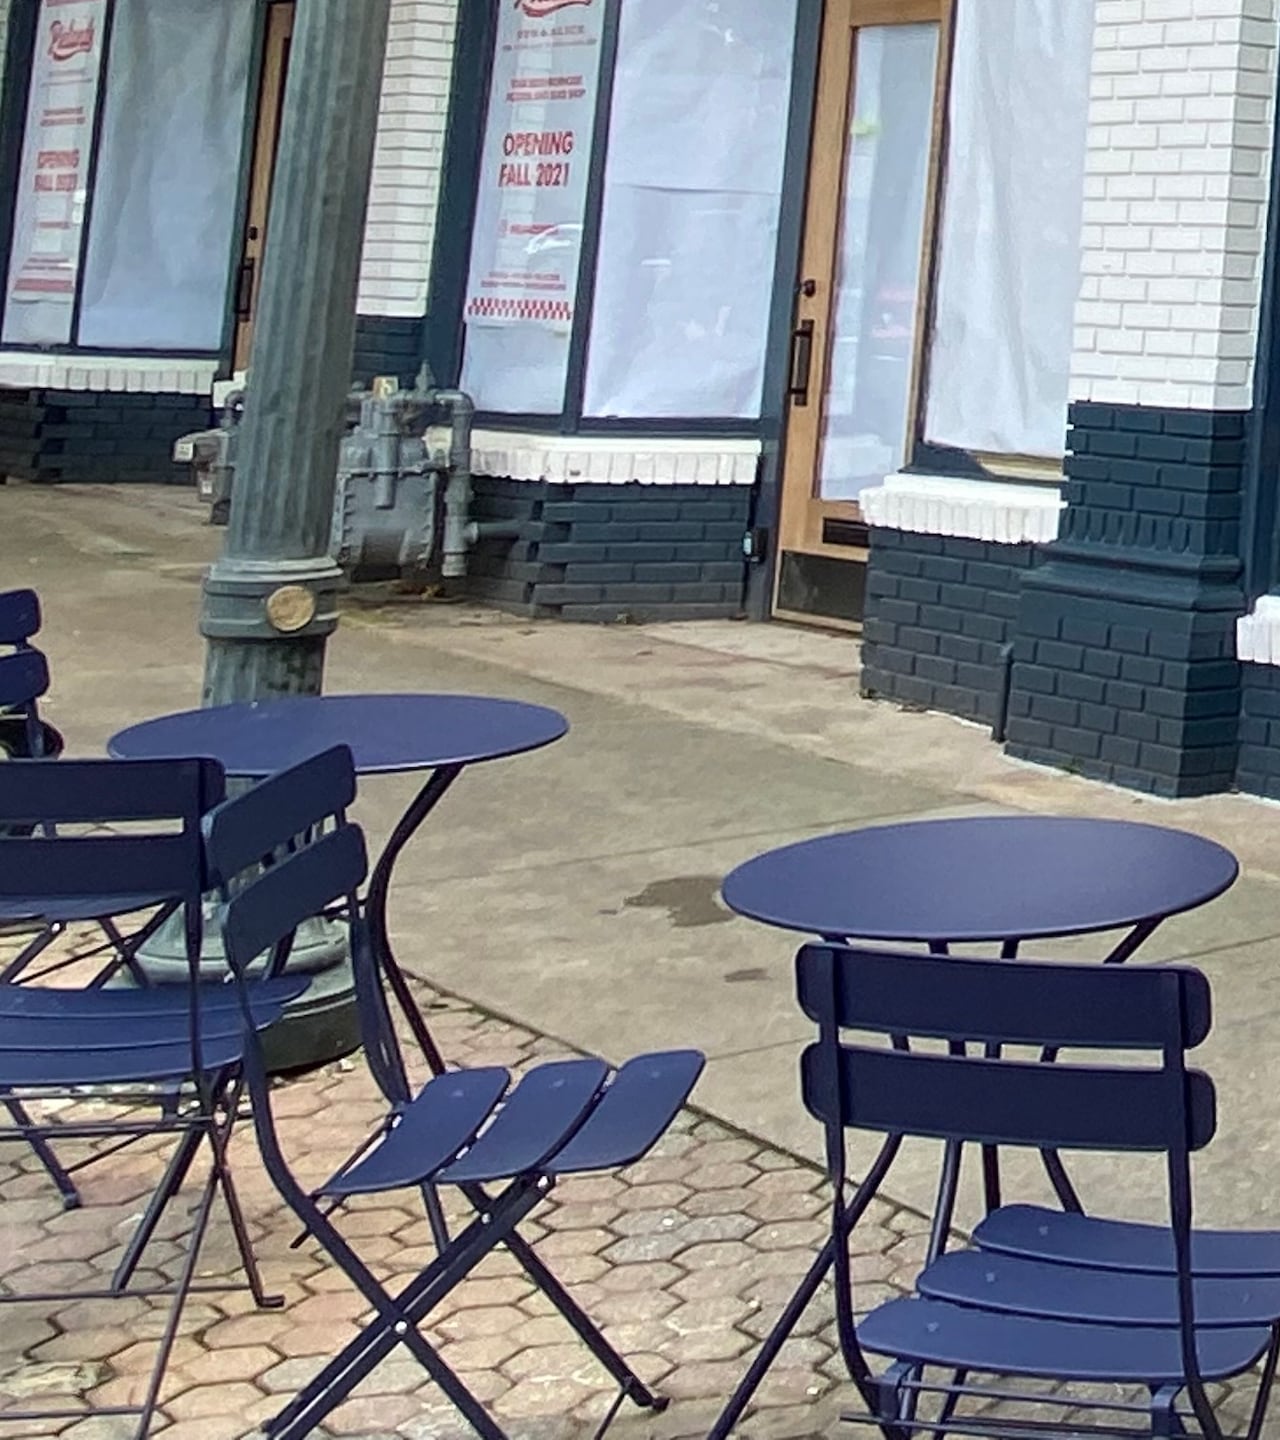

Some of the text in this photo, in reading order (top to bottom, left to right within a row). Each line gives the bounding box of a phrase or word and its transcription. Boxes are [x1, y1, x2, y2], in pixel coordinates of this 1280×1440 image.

[503, 131, 573, 157] OPENING
[498, 162, 570, 188] FALL 2021
